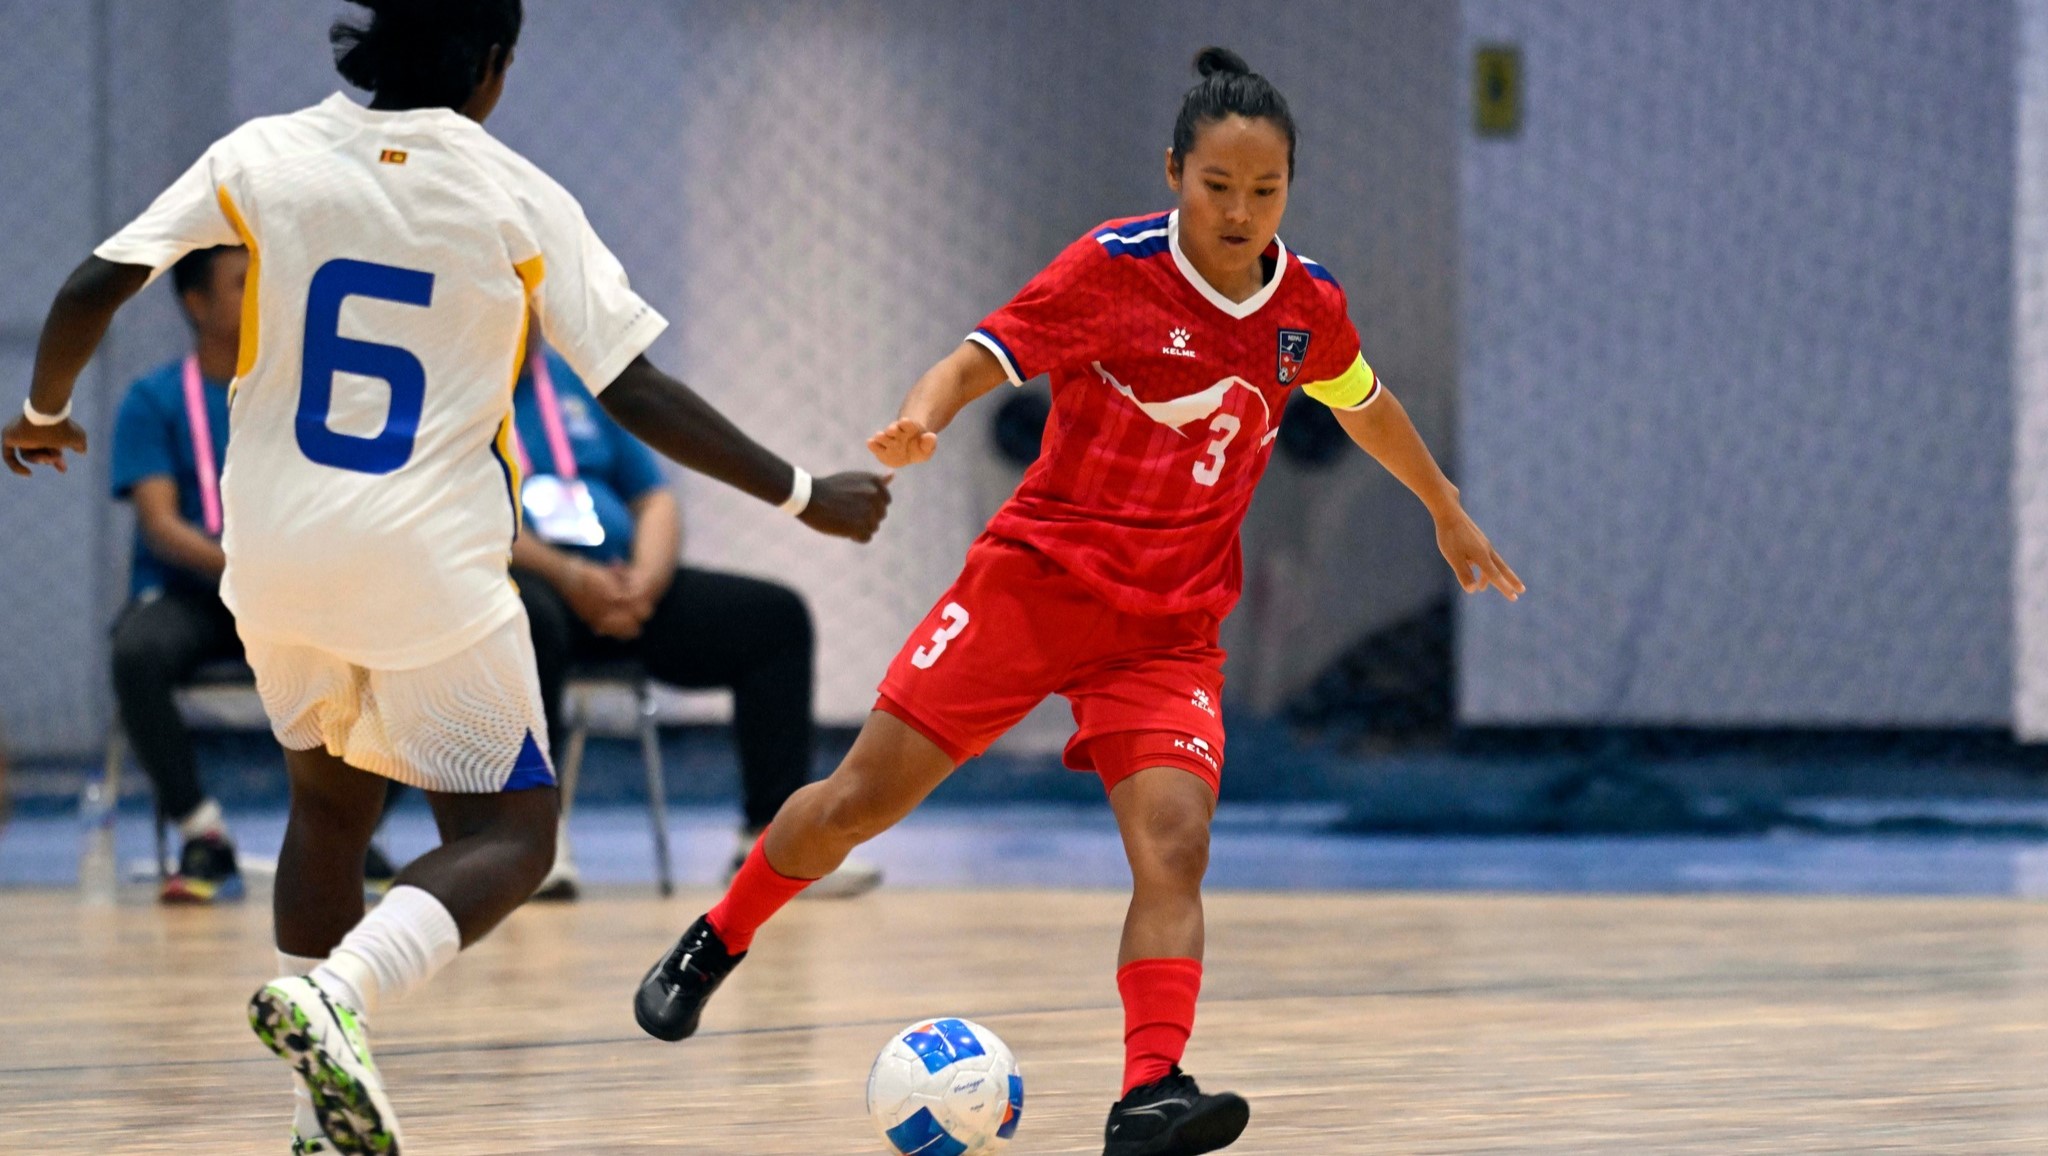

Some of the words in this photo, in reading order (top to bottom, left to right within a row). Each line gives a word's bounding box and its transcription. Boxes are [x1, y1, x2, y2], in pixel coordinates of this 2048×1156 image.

[295, 258, 435, 475] 6
[1162, 346, 1196, 358] KELME
[1192, 413, 1241, 487] 3
[911, 601, 970, 670] 3
